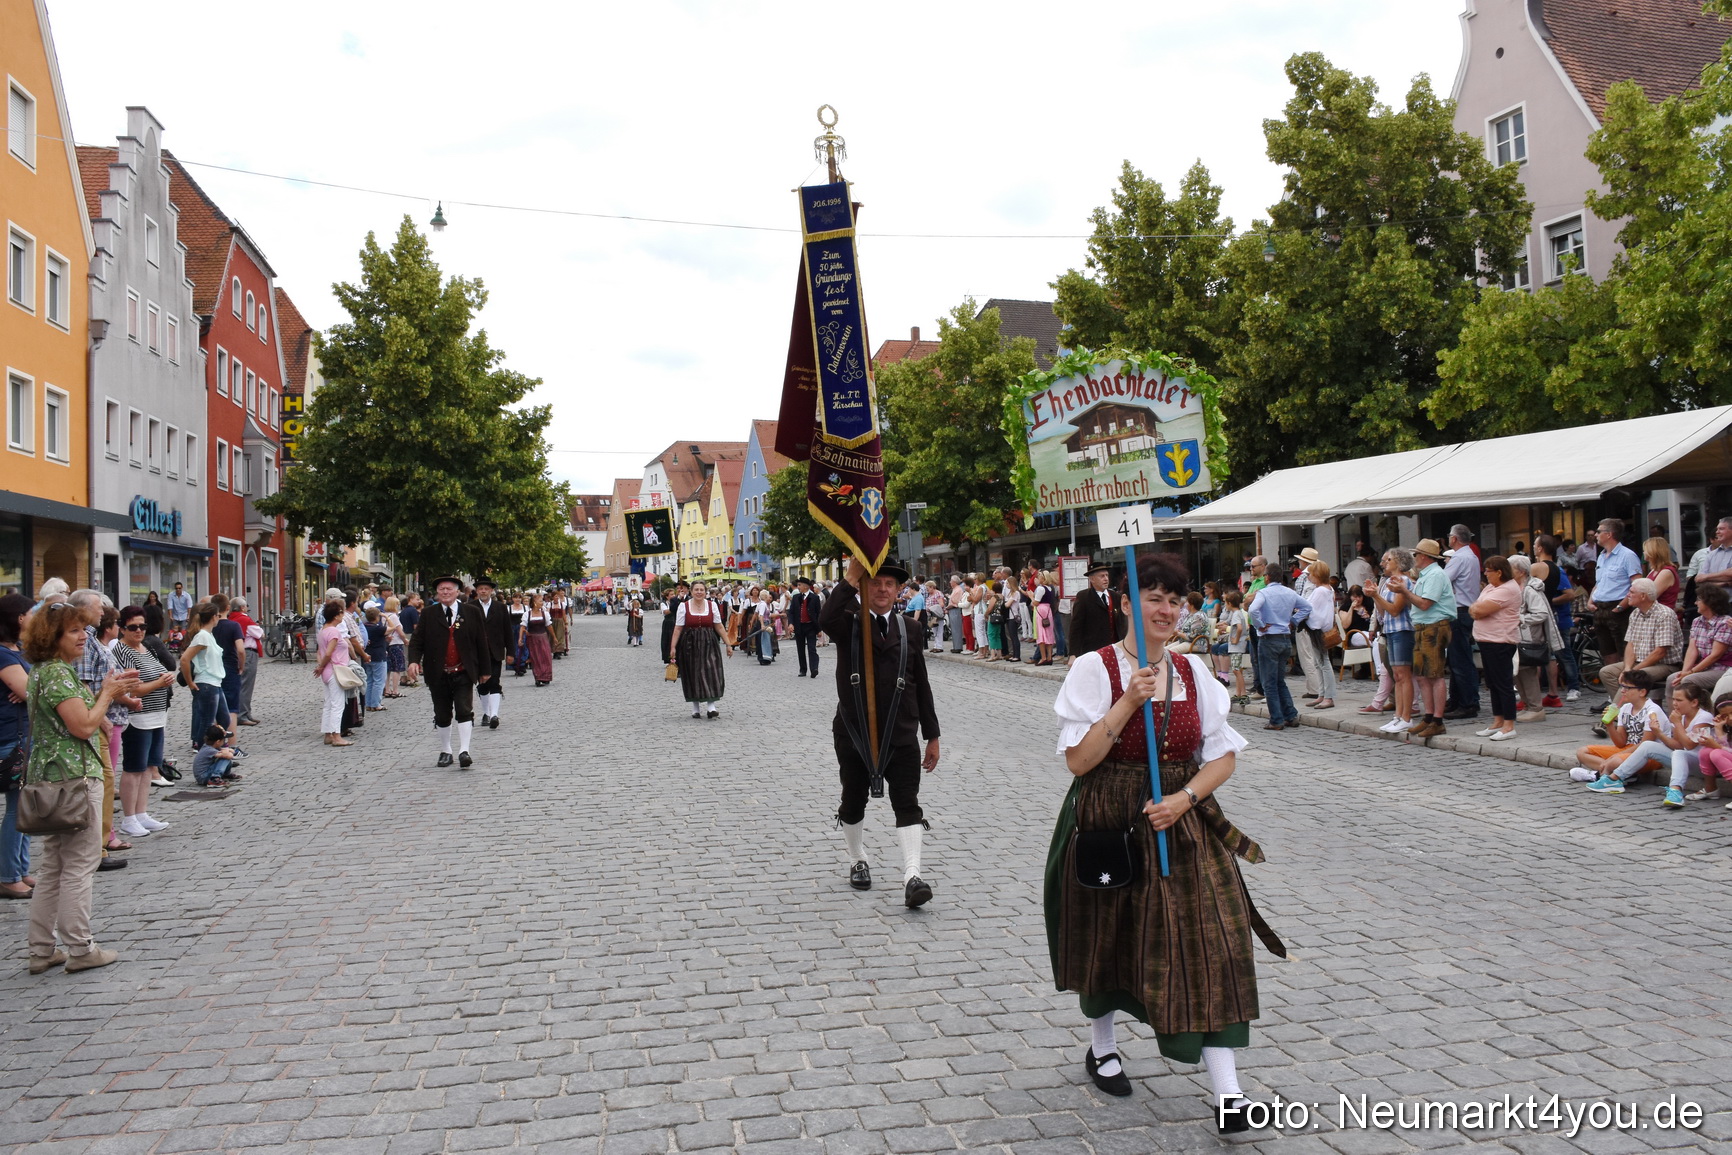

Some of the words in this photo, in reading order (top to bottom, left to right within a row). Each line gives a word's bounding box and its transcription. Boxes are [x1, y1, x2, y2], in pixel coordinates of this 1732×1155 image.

[821, 250, 842, 260] Zum
[819, 262, 829, 272] 50
[824, 283, 846, 297] fest
[822, 297, 850, 310] gewidmet
[827, 324, 853, 375] Patenverein
[832, 401, 864, 410] Hirschau
[1039, 470, 1149, 509] Schnaittenbach
[1117, 518, 1141, 537] 41
